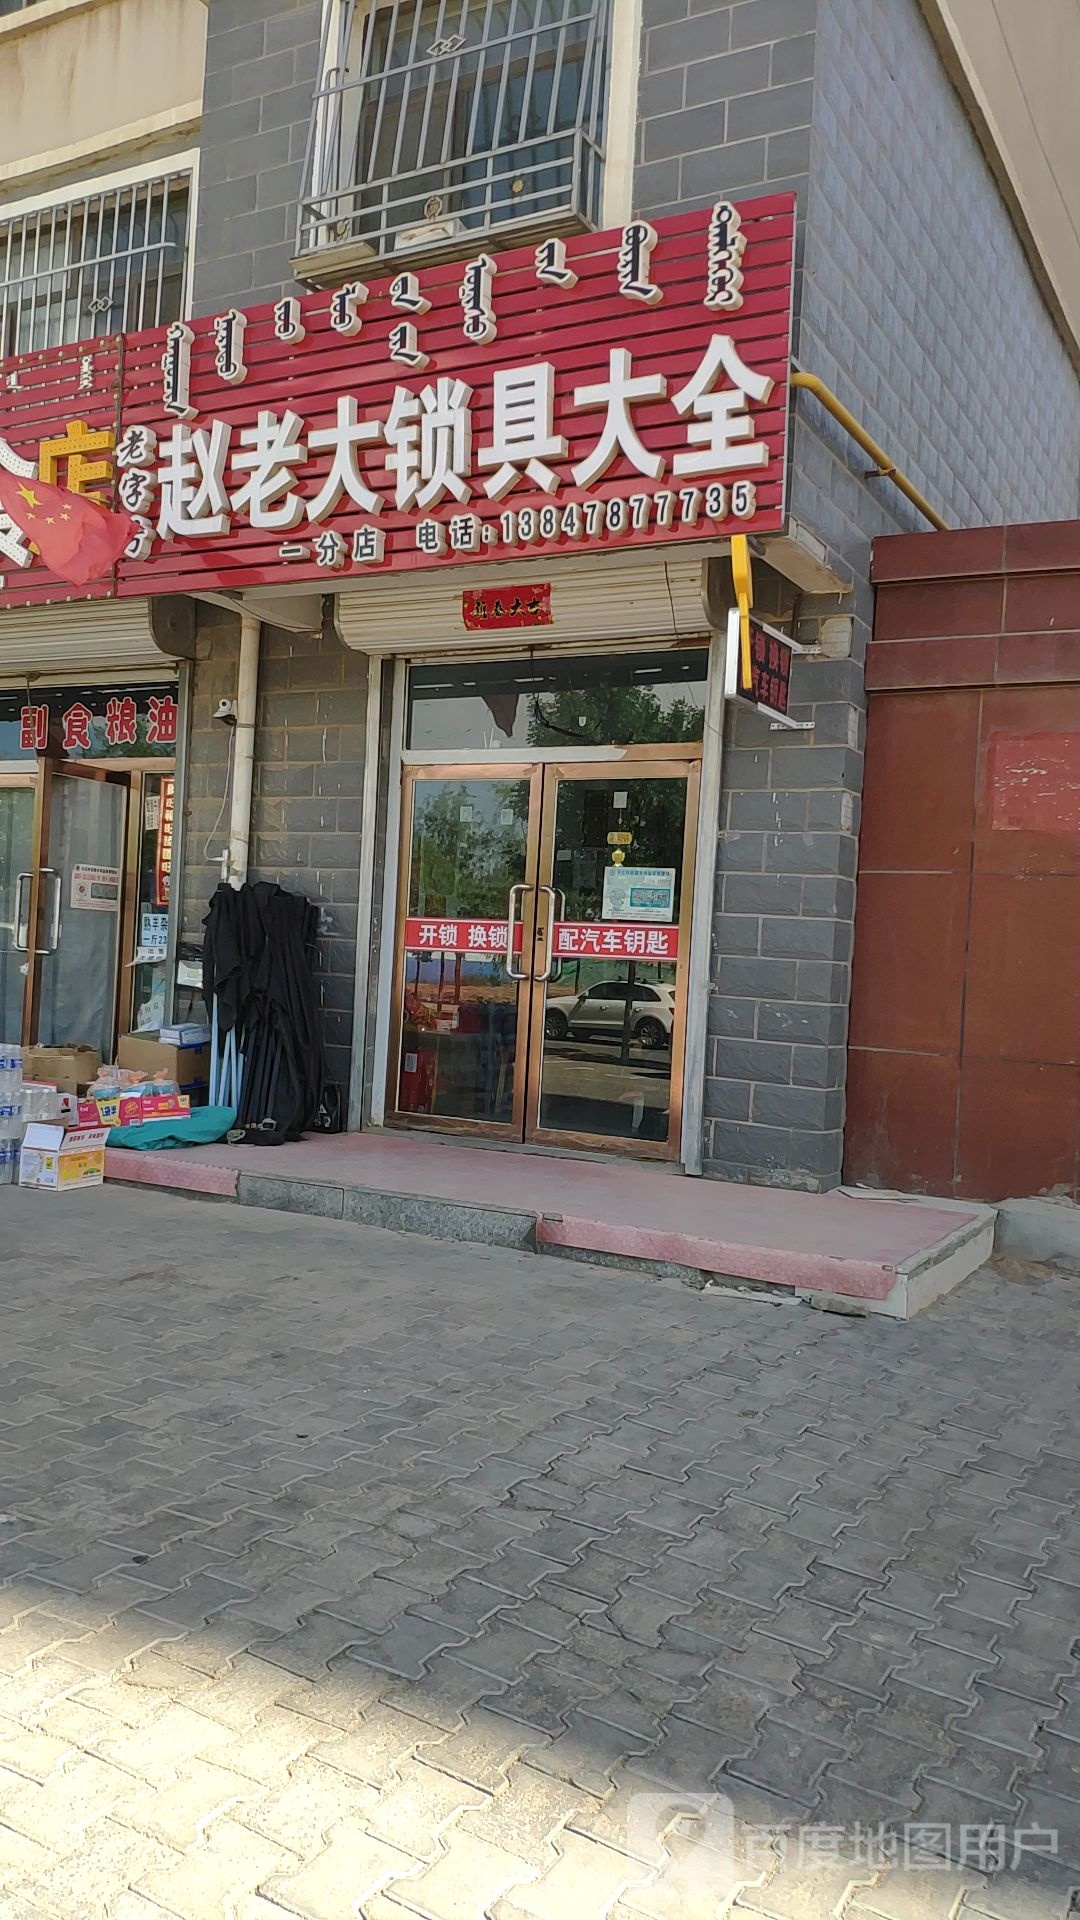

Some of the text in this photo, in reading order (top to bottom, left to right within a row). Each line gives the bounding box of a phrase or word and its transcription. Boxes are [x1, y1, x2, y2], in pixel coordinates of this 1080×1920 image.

[157, 334, 774, 540] 赵老大锁具大全
[279, 524, 386, 567] 一分店
[20, 695, 178, 749] 副食粮油
[419, 924, 457, 946] 开锁
[558, 928, 669, 954] 配汽车钥匙
